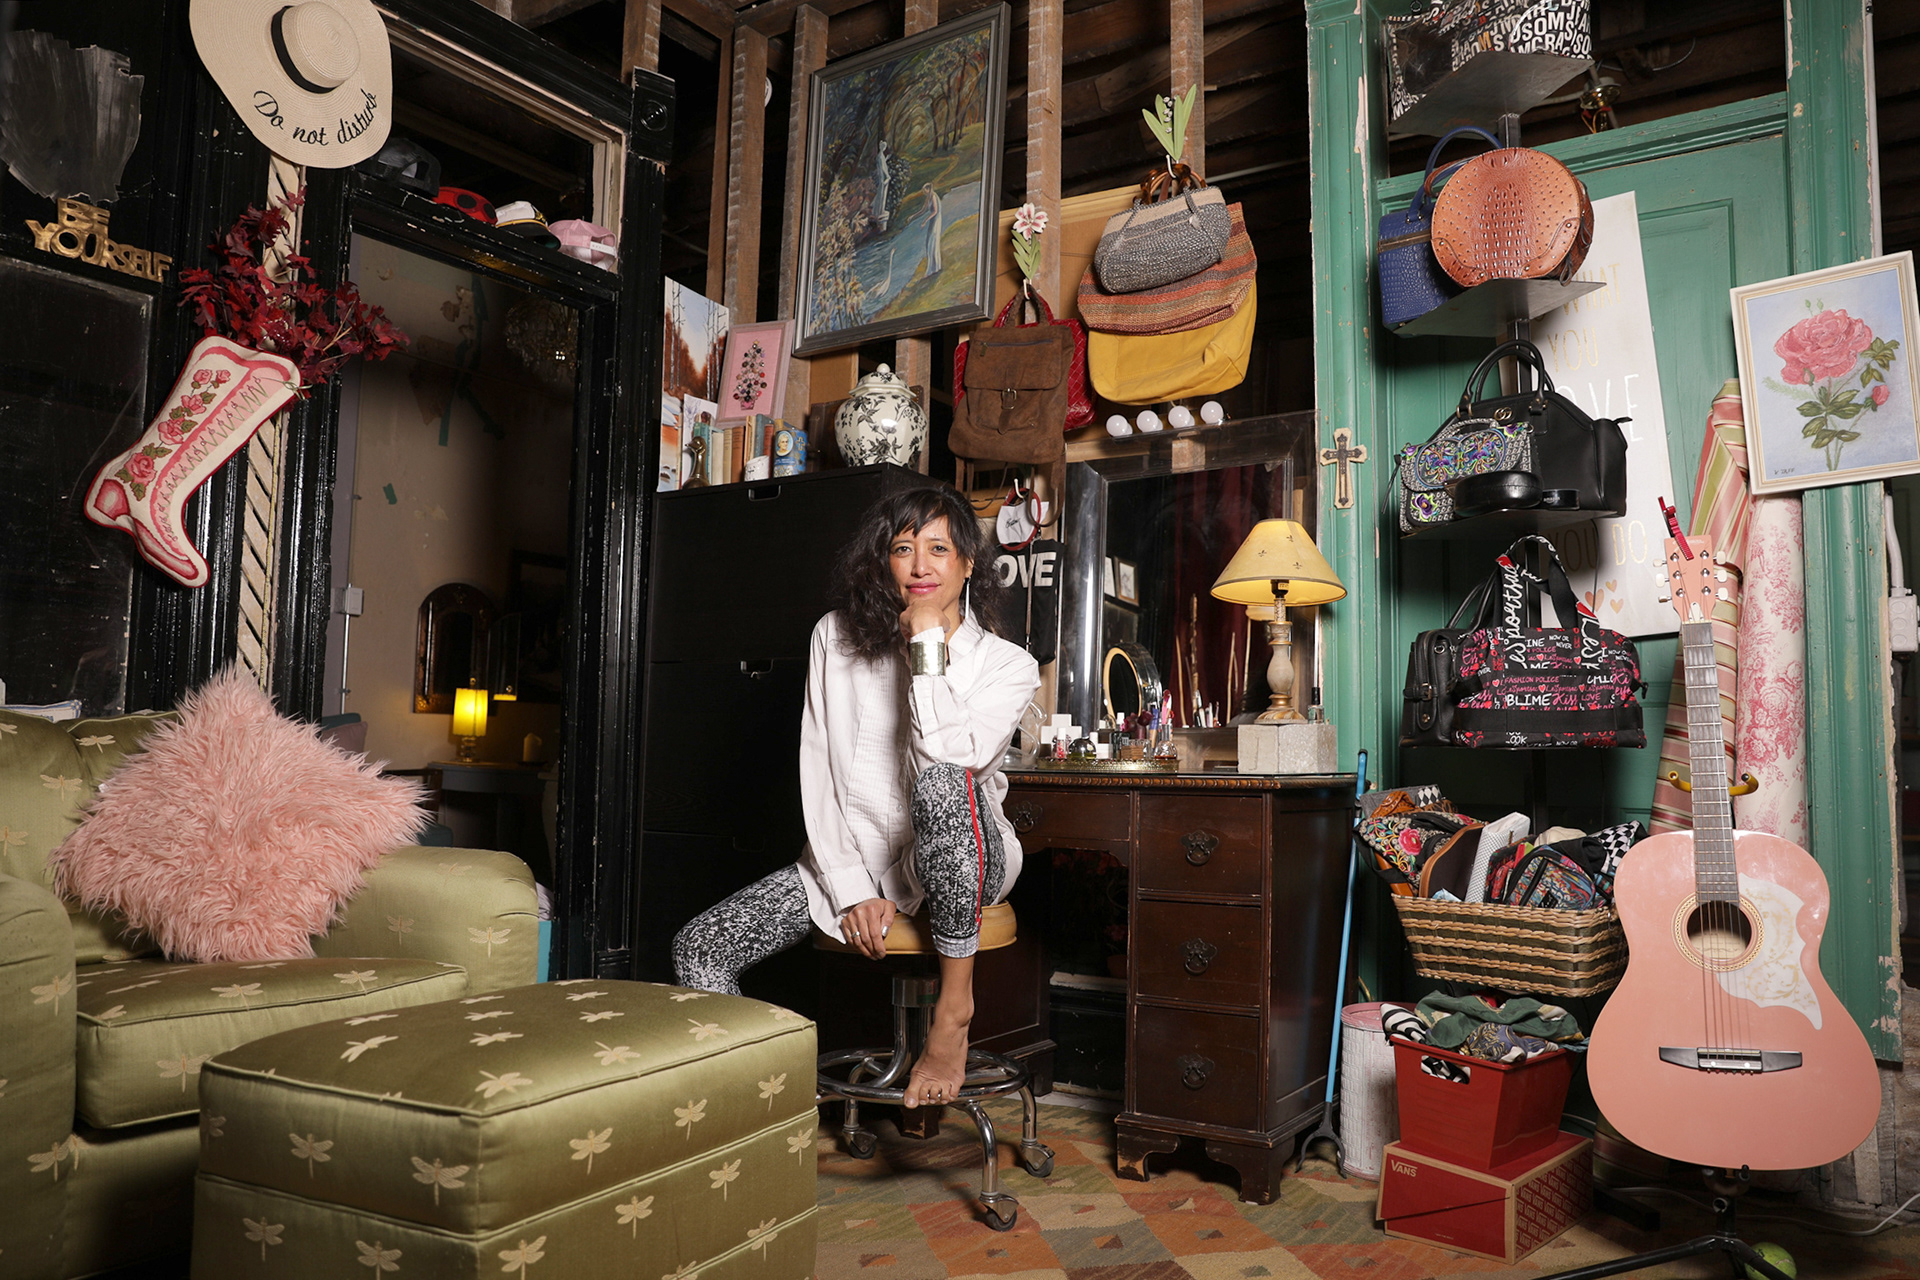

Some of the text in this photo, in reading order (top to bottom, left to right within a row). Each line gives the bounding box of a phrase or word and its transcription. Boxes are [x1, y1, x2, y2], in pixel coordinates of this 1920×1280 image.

[253, 88, 378, 146] Do not disturb
[58, 198, 111, 230] BE
[25, 219, 173, 283] YOURSELF
[1547, 326, 1600, 373] YOU
[1612, 520, 1648, 566] DO
[992, 552, 1057, 588] OVE
[1503, 563, 1528, 670] eSportsac
[1525, 637, 1546, 648] INE
[1535, 675, 1560, 683] POLICE
[1506, 693, 1552, 706] BLIME
[1581, 693, 1601, 701] LOVE
[1391, 1159, 1418, 1178] VANS
